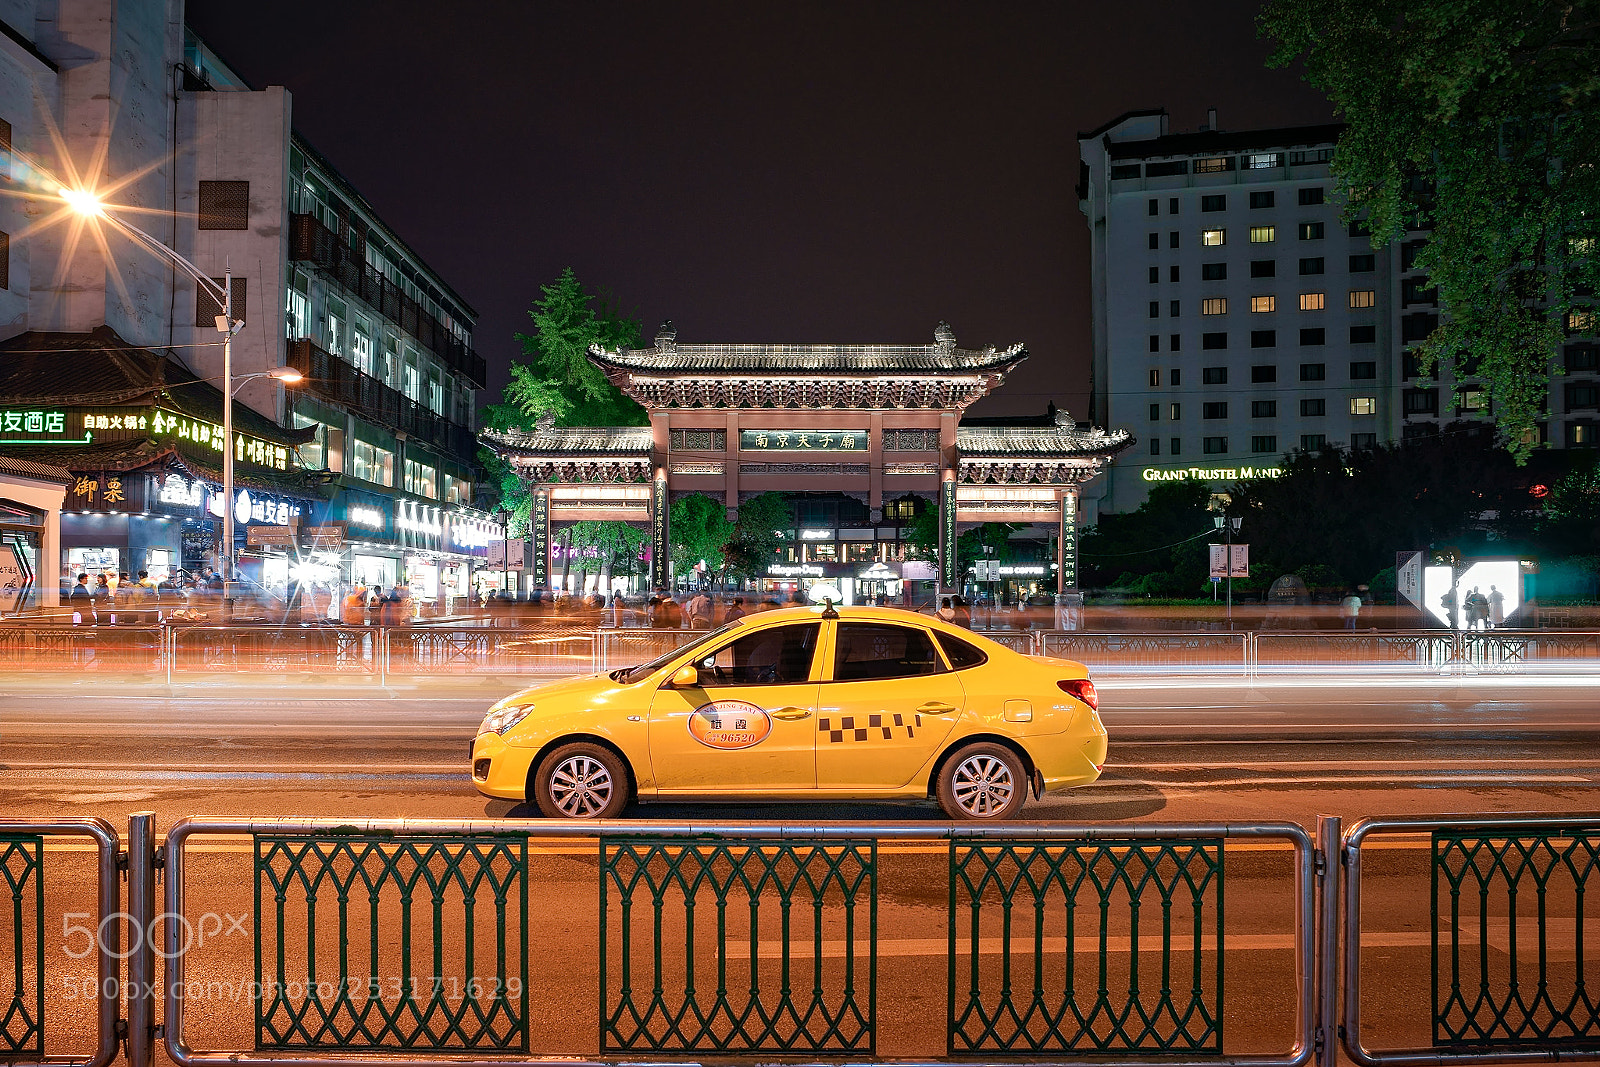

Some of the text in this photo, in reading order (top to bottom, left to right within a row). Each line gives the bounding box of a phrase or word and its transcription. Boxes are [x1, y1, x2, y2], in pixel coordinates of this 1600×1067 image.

[0, 411, 64, 432] 友酒店
[84, 414, 138, 430] 自助火锅
[1143, 468, 1188, 481] GRAND
[1188, 467, 1238, 480] TRUSTEL
[704, 702, 756, 715] NANJING TAXI
[720, 733, 755, 743] 96520
